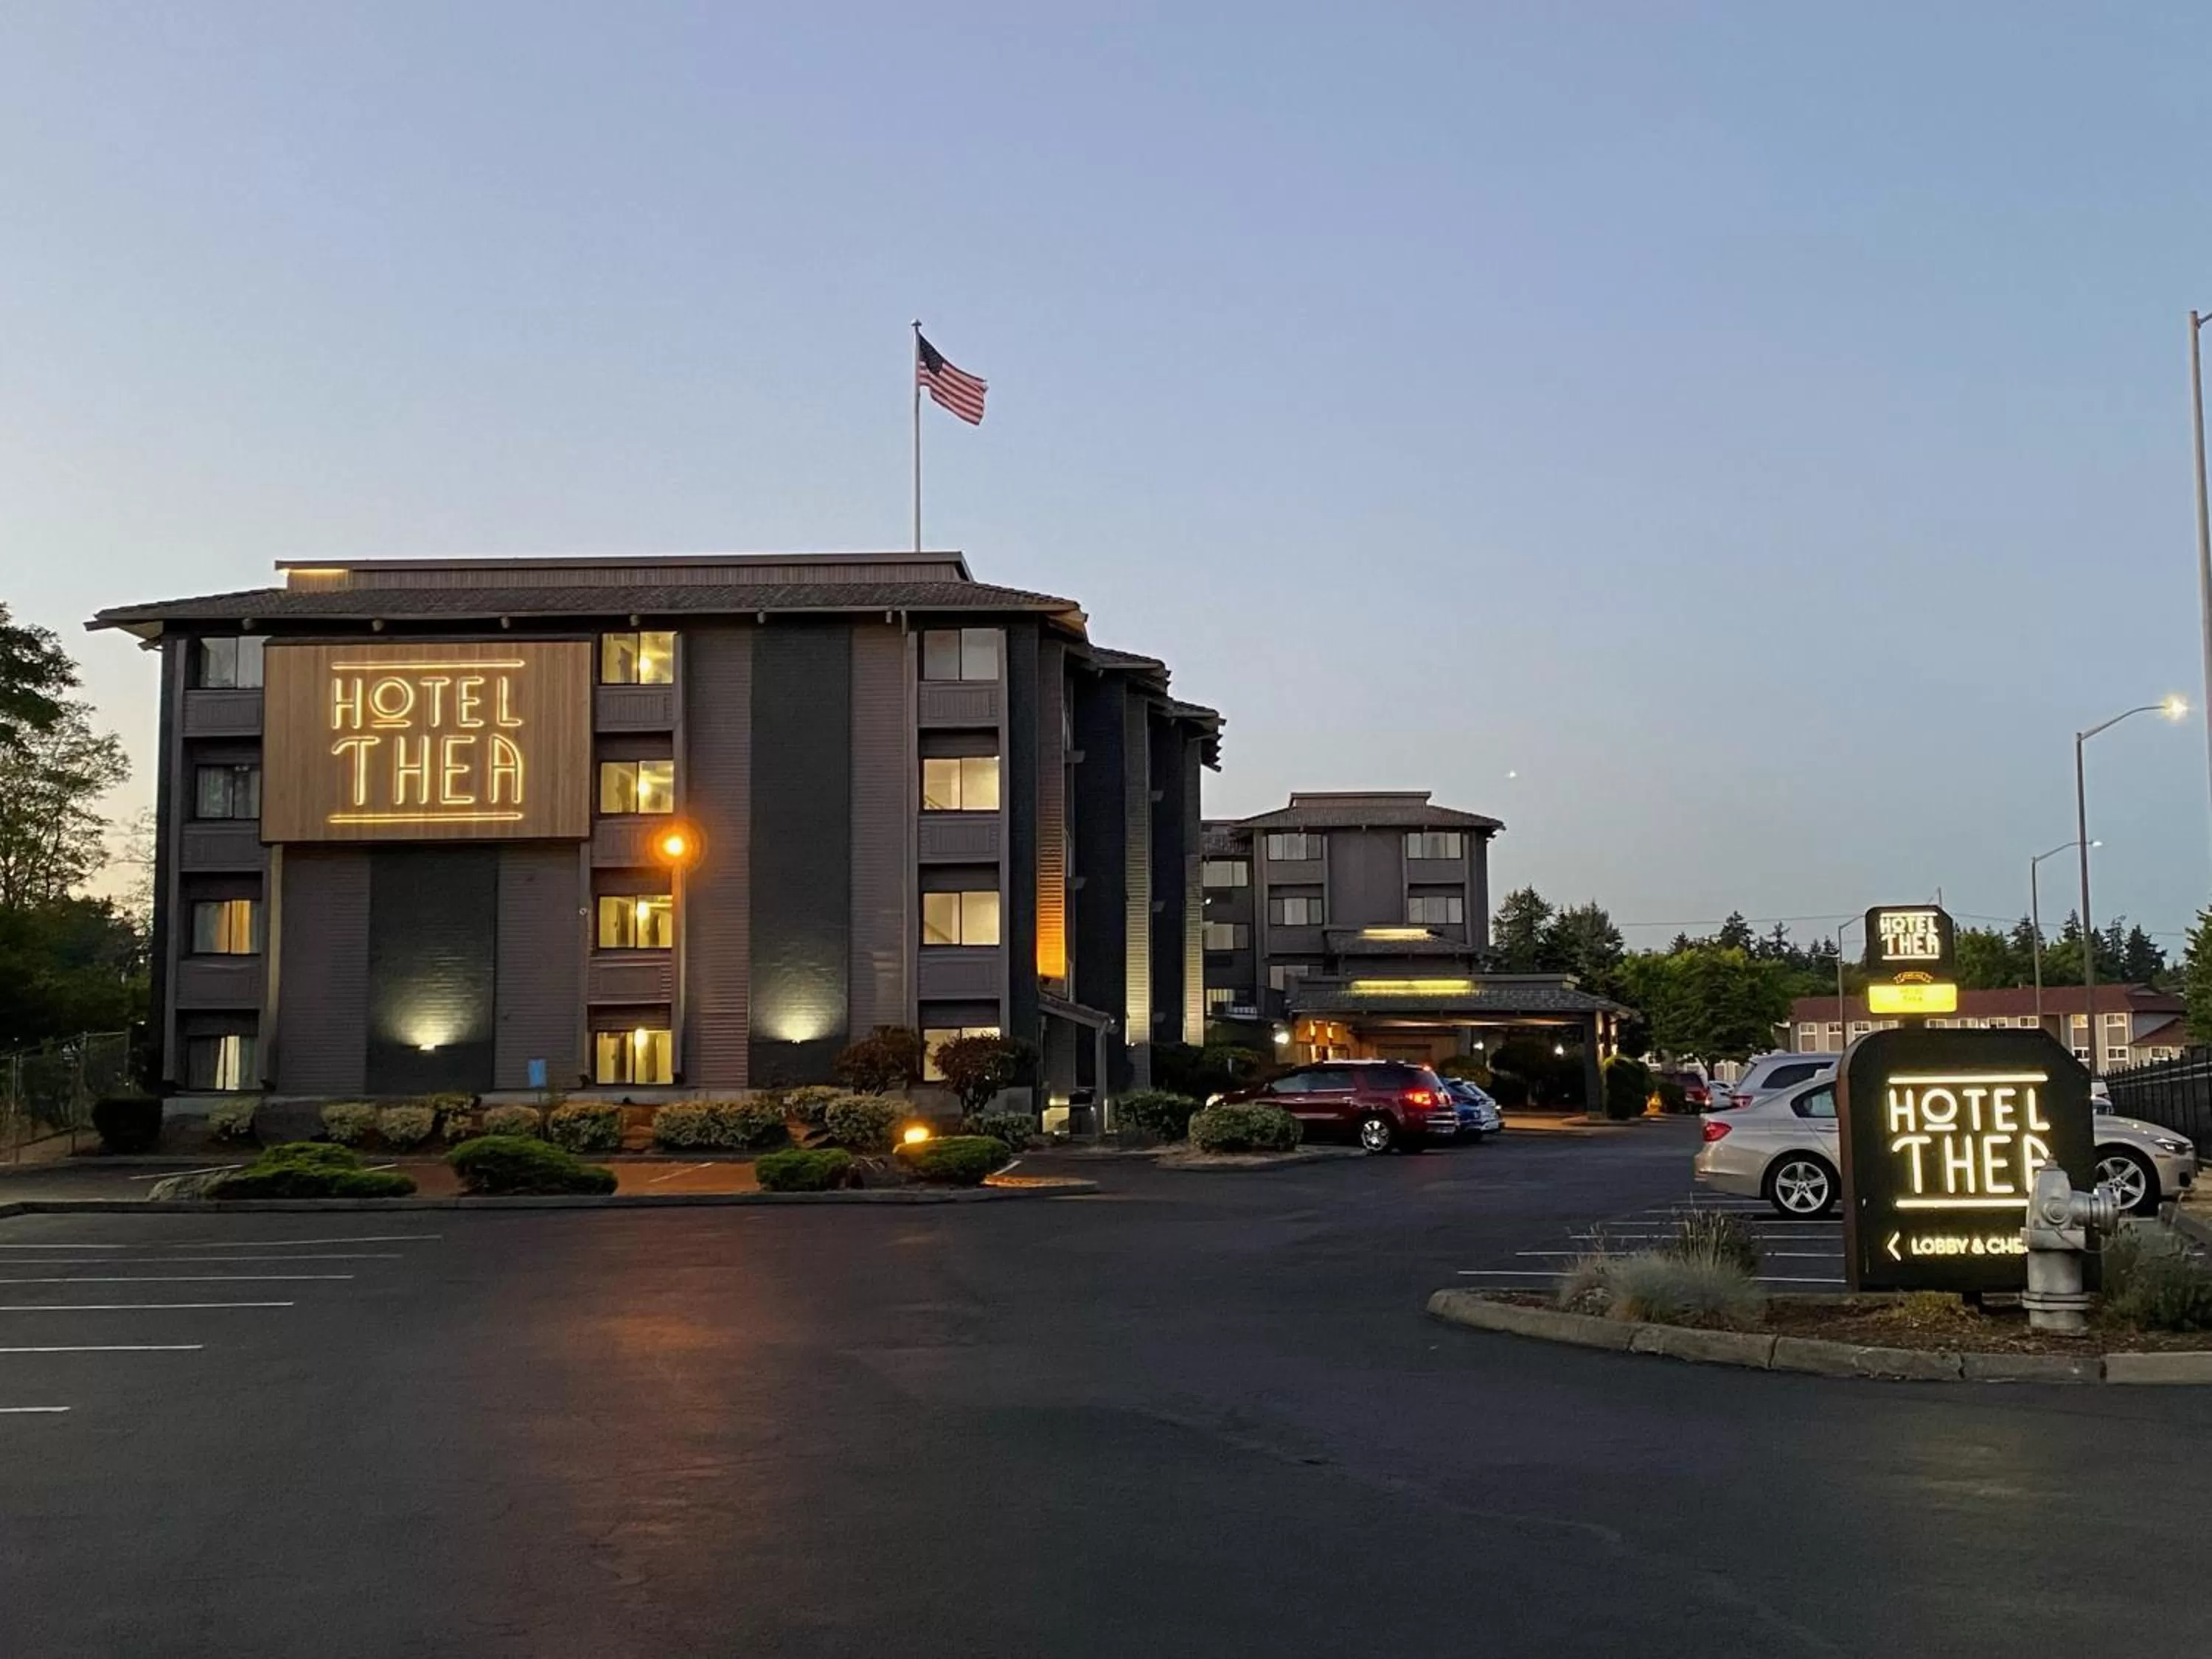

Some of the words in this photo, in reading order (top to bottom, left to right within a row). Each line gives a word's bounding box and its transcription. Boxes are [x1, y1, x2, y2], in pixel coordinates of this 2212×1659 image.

[331, 676, 524, 729] HOTEL
[331, 734, 525, 806] THEA
[1879, 917, 1939, 933] HOTEL
[1881, 933, 1940, 955] THEA
[1888, 1088, 2051, 1132] HOTEL
[1911, 1237, 1969, 1254] LOBBY
[1971, 1237, 1986, 1254] &
[1986, 1237, 2029, 1254] CHE
